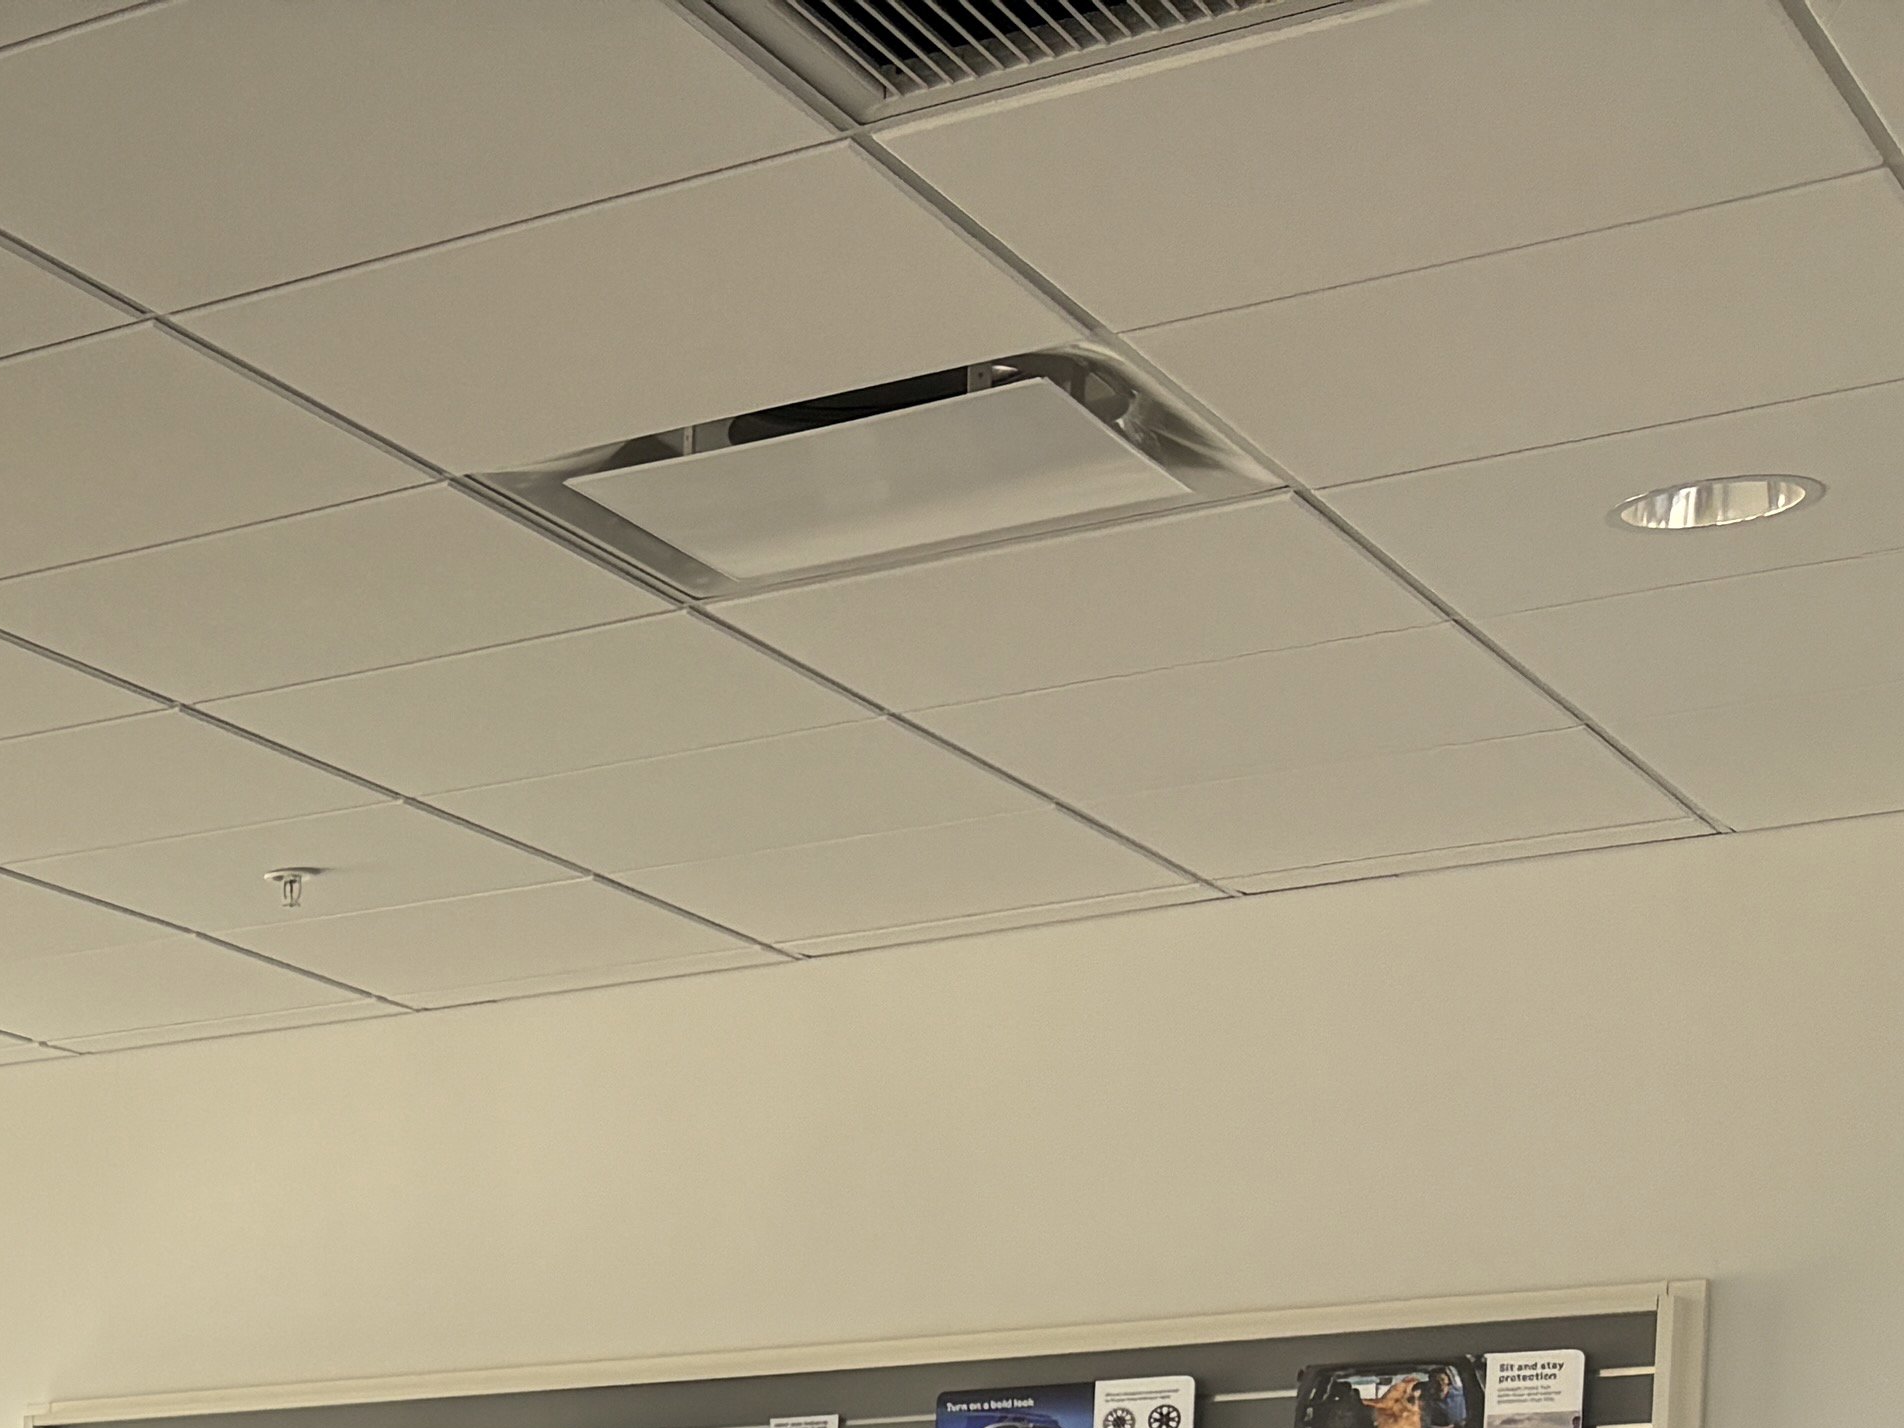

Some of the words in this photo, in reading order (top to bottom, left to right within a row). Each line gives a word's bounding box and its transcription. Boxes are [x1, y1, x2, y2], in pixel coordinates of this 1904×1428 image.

[1517, 1362, 1538, 1372] and
[1498, 1372, 1557, 1384] protection
[946, 1401, 967, 1412] Turn
[969, 1402, 981, 1411] on
